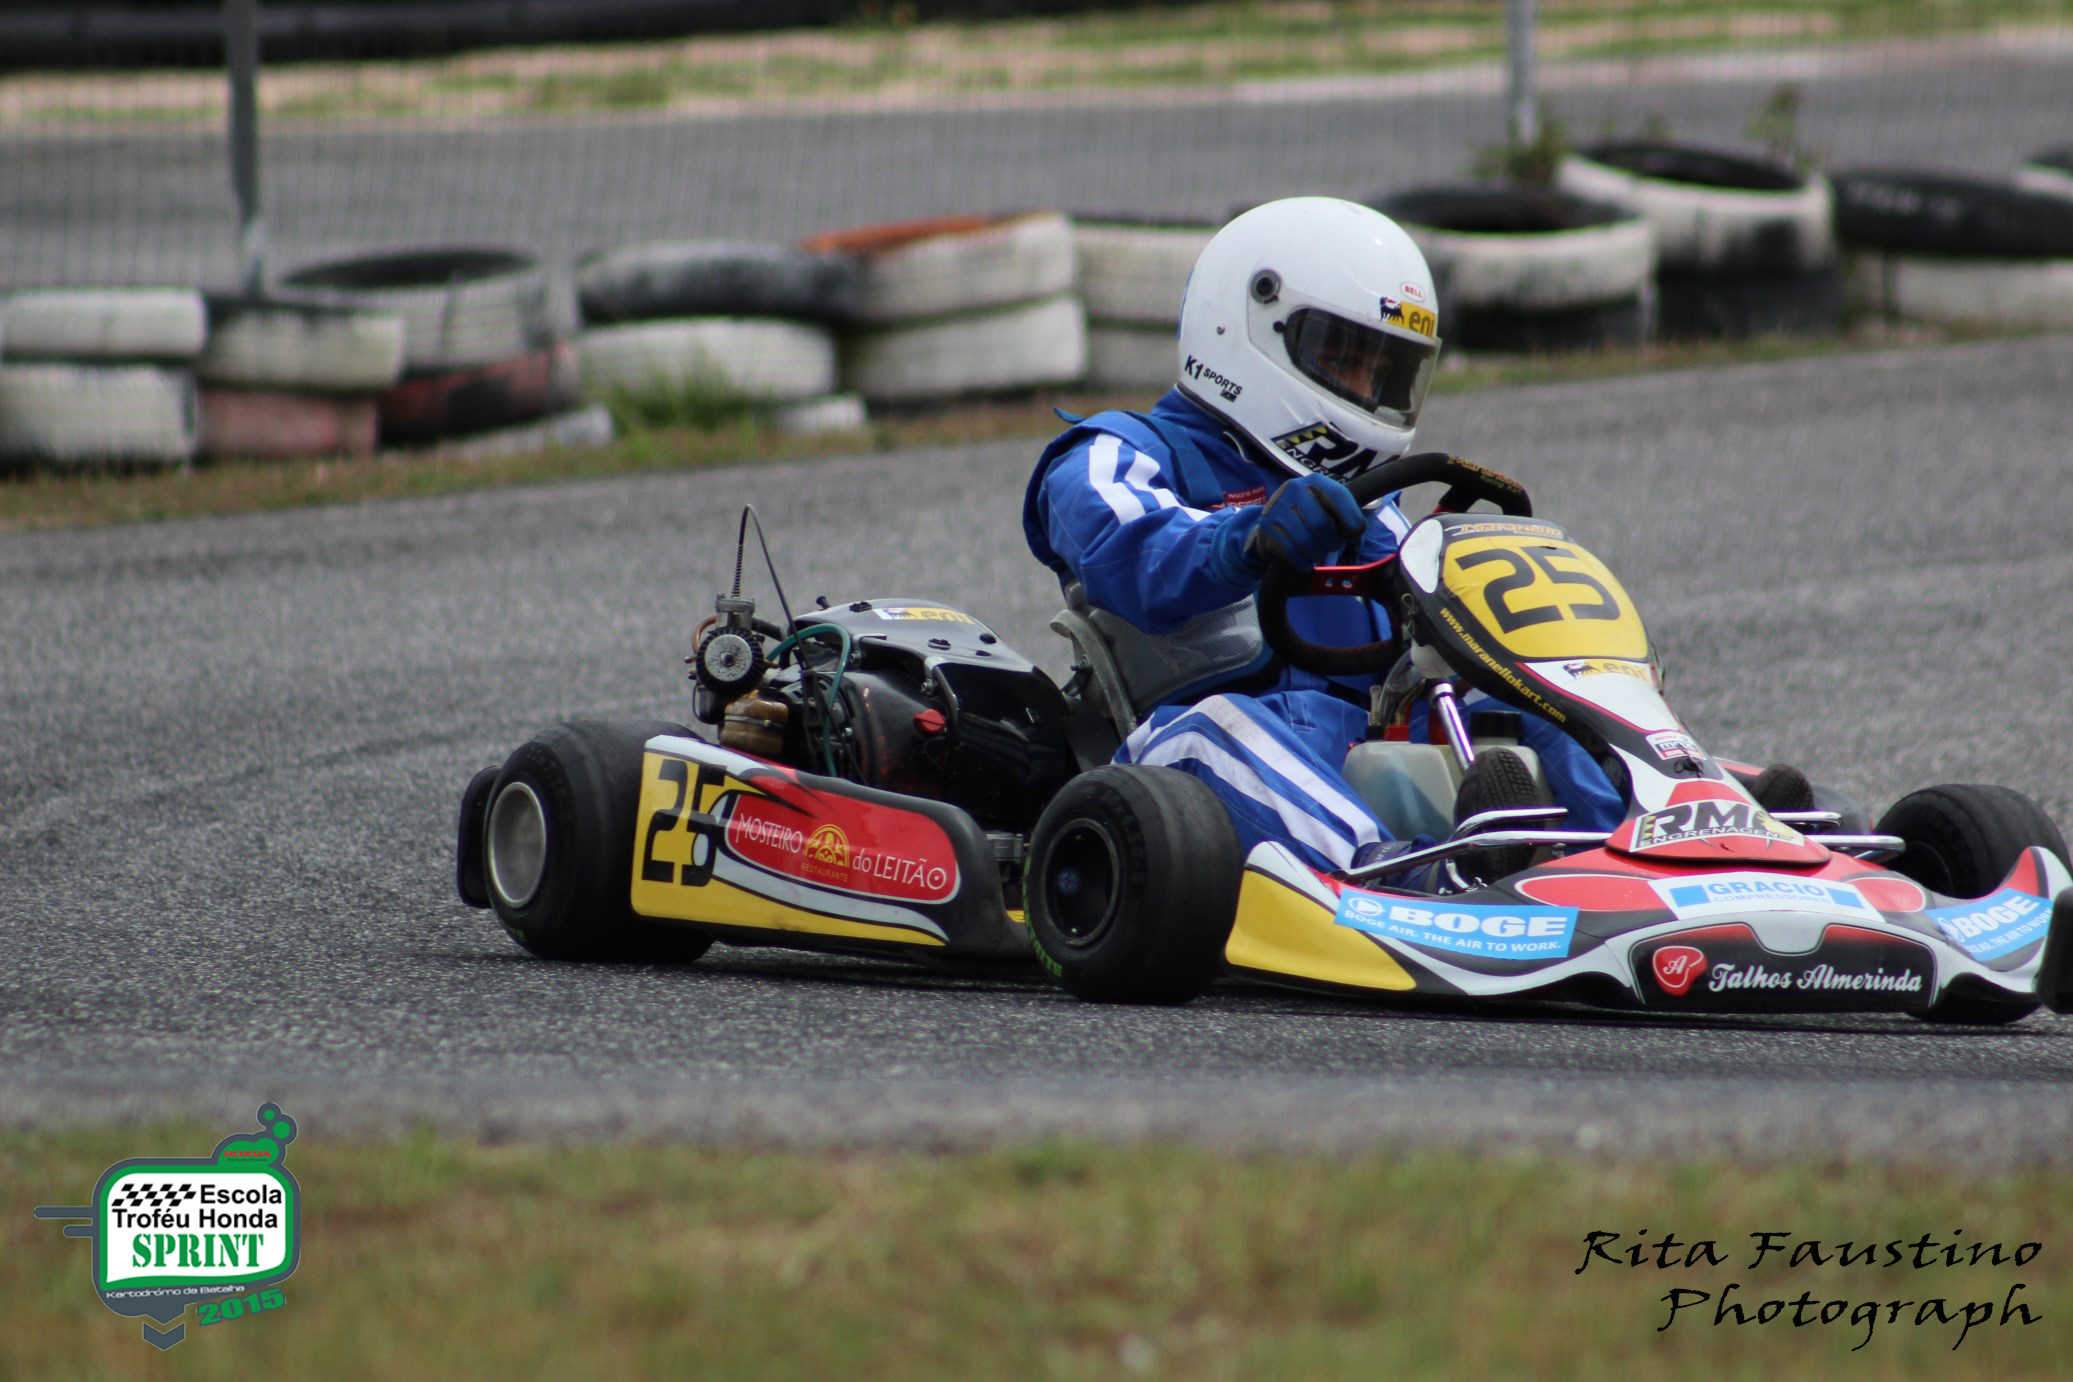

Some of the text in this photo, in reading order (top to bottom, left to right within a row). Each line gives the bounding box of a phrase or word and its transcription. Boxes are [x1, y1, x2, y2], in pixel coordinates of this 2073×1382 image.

[1404, 285, 1422, 298] BELL
[1184, 355, 1242, 395] K1 SPORTS
[1455, 546, 1621, 634] 25
[1440, 607, 1566, 723] www.maranellokart.com
[641, 759, 728, 887] 25
[735, 813, 947, 890] MOSTEIRO do LEITÃO
[801, 862, 848, 882] RESTAURANTE
[1708, 881, 1824, 896] GRACIO
[1714, 893, 1831, 904] COMPRESSORES
[1952, 896, 2040, 938] BOGE
[1345, 910, 1561, 952] BOGE AIR. THE AIR TO WORK.
[1389, 906, 1567, 937] BOGE
[1708, 963, 1923, 992] Talhos Almerinda
